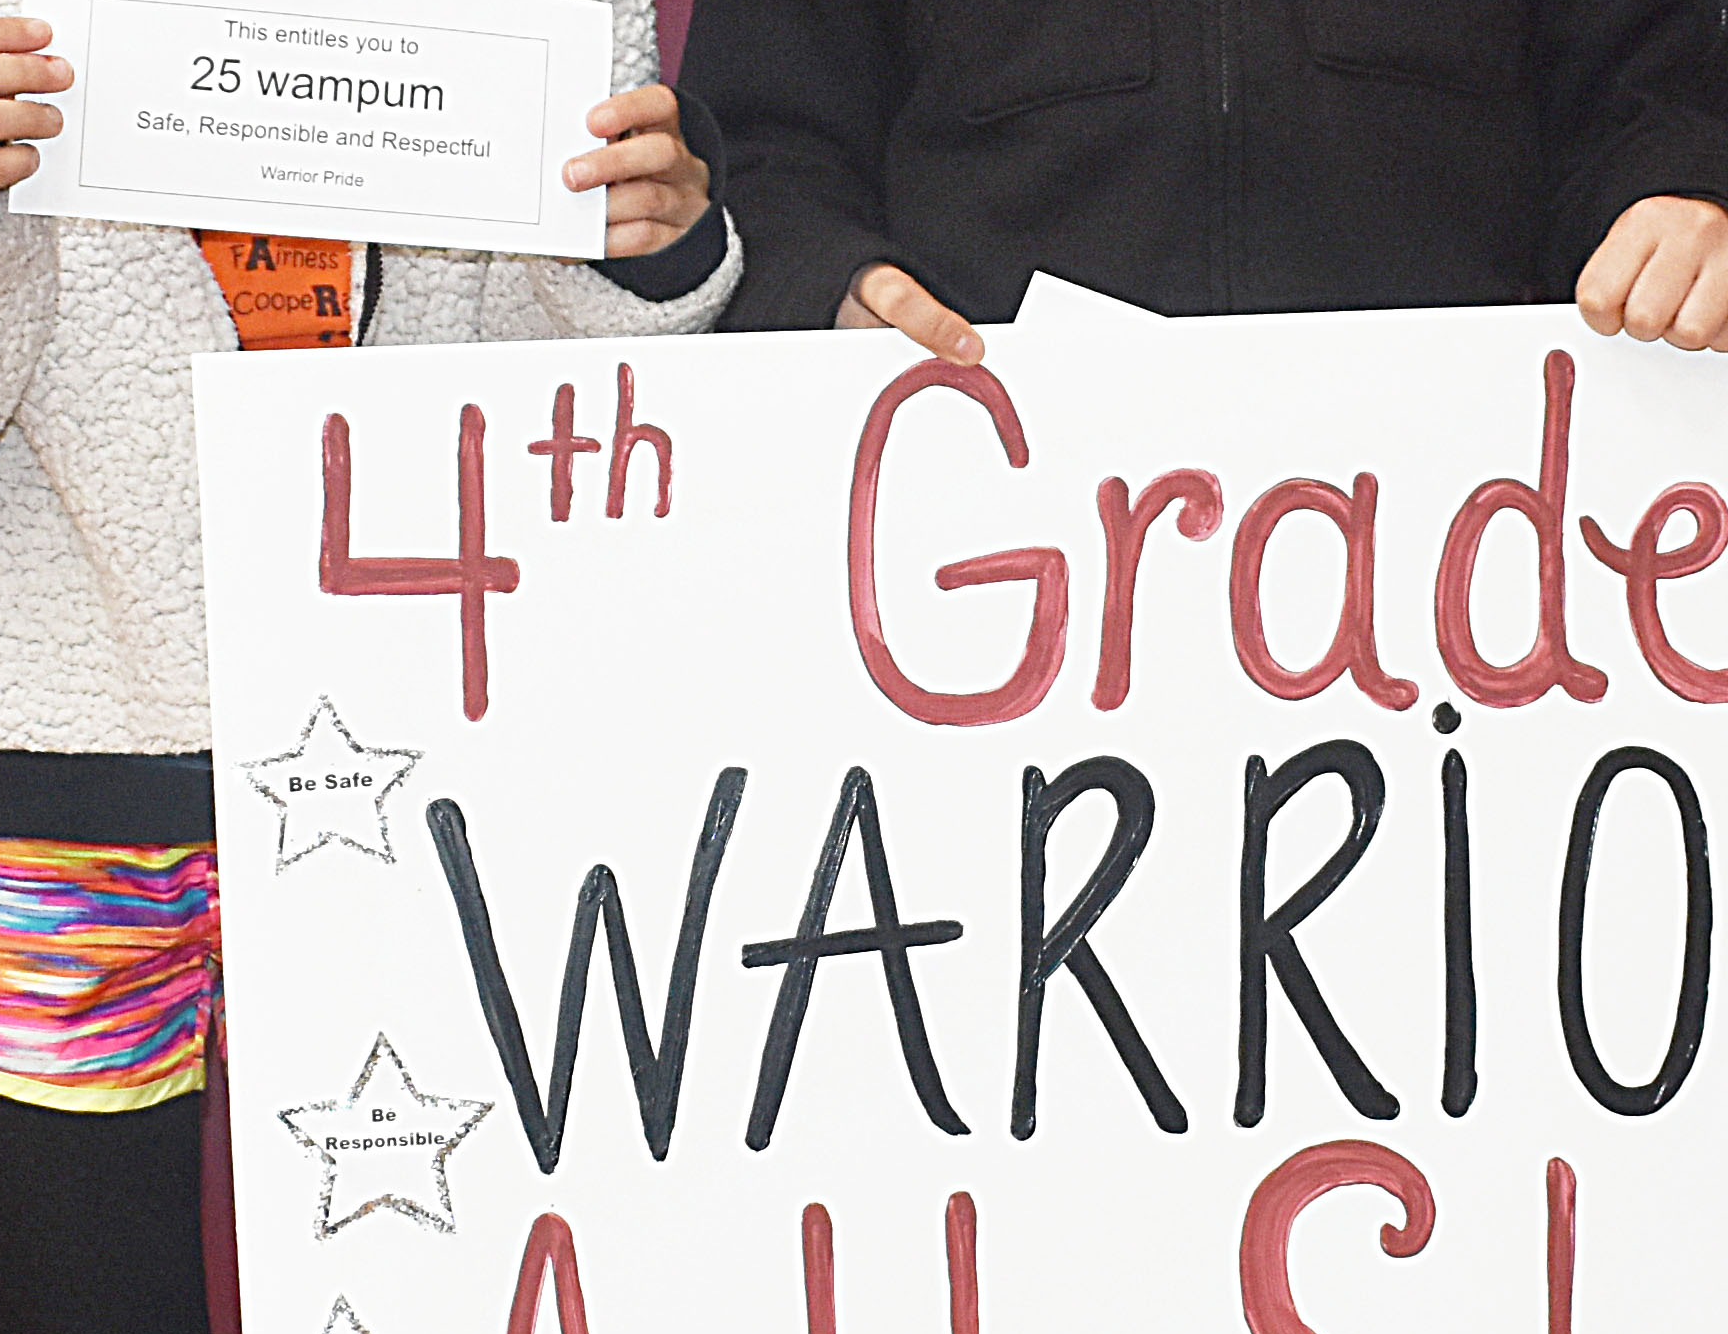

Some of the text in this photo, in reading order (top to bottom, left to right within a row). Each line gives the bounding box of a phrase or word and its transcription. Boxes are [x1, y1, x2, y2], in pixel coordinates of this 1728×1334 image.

[224, 19, 419, 55] This entitles you to
[190, 55, 444, 114] 25 wampum
[136, 110, 491, 158] Safe, Responsible and Respectful
[260, 165, 365, 188] Warrior Pride
[320, 362, 673, 722] 4th
[289, 772, 372, 791] Be Safe
[372, 1108, 396, 1123] Be
[325, 1132, 445, 1151] Responsible
